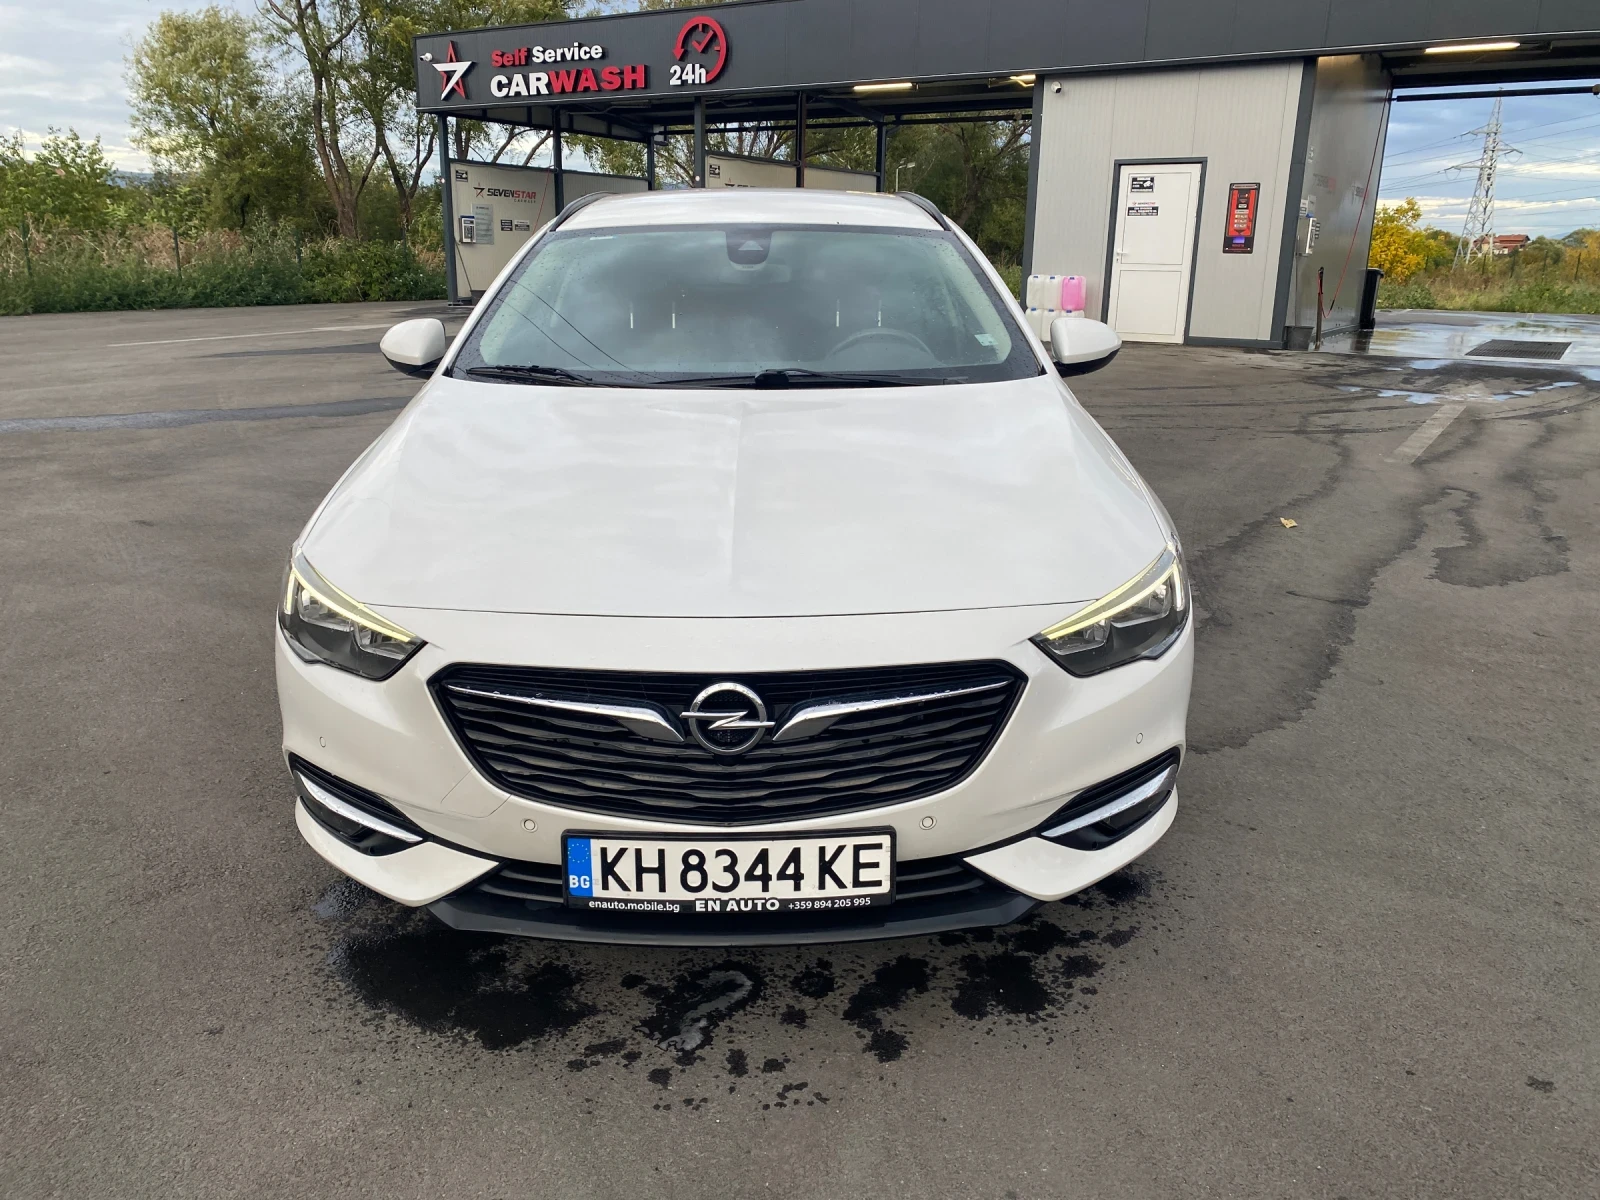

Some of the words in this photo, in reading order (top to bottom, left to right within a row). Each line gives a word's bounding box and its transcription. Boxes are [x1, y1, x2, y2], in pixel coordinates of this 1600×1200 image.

[491, 47, 528, 67] Self
[531, 42, 603, 63] Service
[490, 64, 645, 97] CARWASH
[669, 63, 707, 86] 24h
[487, 188, 537, 199] SEVENSTAR
[600, 847, 667, 893] KH
[679, 848, 805, 894] 8344
[817, 842, 884, 891] KE
[569, 875, 590, 889] BG
[588, 900, 680, 912] enauto.mobile.bg
[695, 899, 722, 912] EN
[726, 899, 780, 912] AUTO
[788, 902, 812, 910] +359
[814, 901, 832, 909] 894
[834, 899, 852, 908] 205
[853, 897, 871, 907] 995
